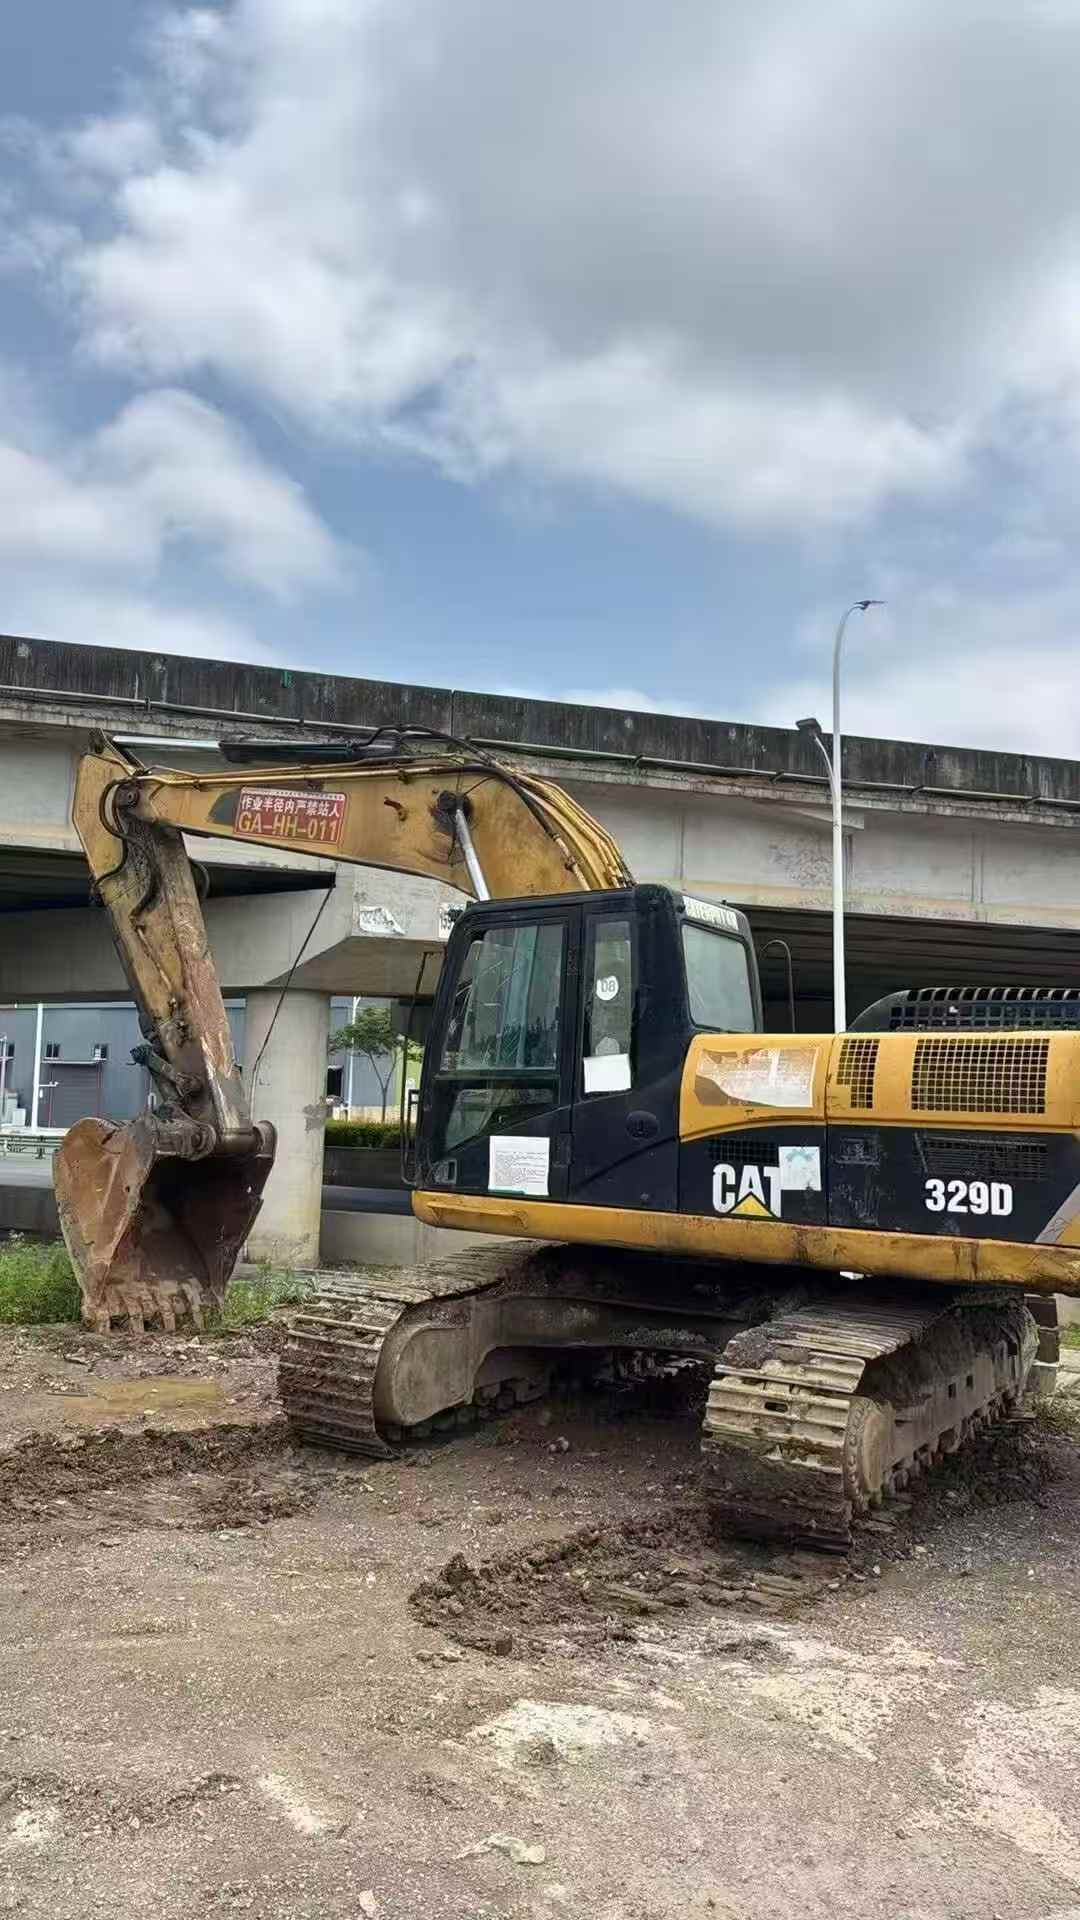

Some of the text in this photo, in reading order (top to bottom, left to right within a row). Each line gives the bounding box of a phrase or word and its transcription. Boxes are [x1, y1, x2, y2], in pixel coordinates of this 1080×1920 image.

[238, 811, 338, 841] GA-HH-011
[712, 1163, 781, 1218] CAT
[925, 1178, 1013, 1216] 329D
